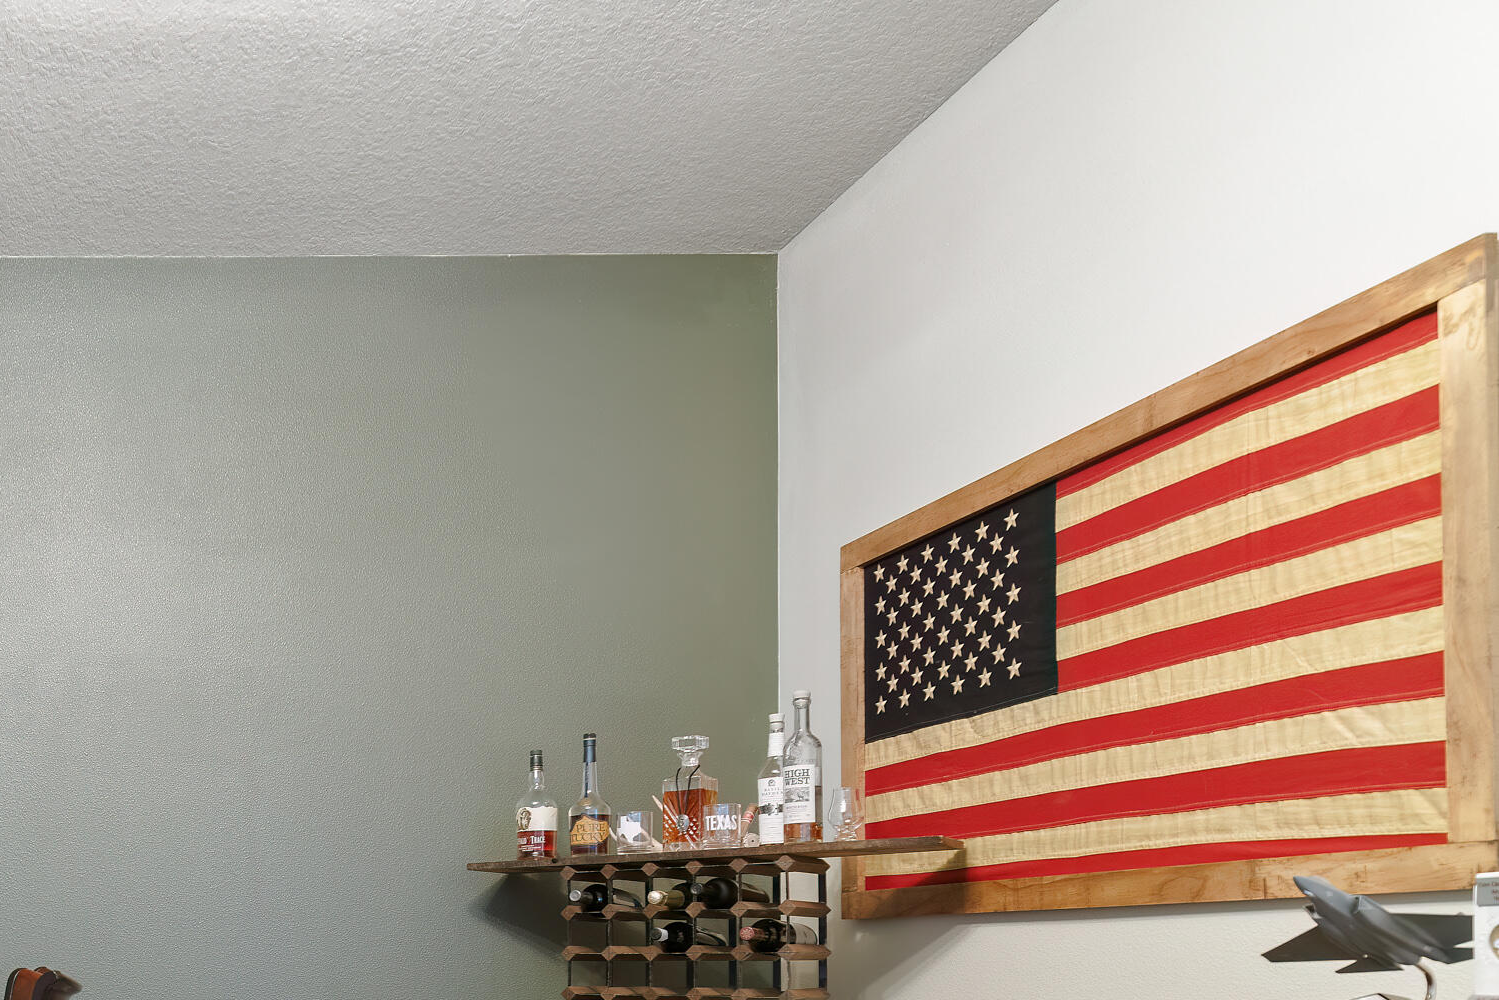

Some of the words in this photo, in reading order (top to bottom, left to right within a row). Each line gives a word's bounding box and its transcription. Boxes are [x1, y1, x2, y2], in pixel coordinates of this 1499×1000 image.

[784, 768, 810, 779] HIGH
[784, 777, 810, 786] WEST
[705, 814, 738, 831] TEXAS
